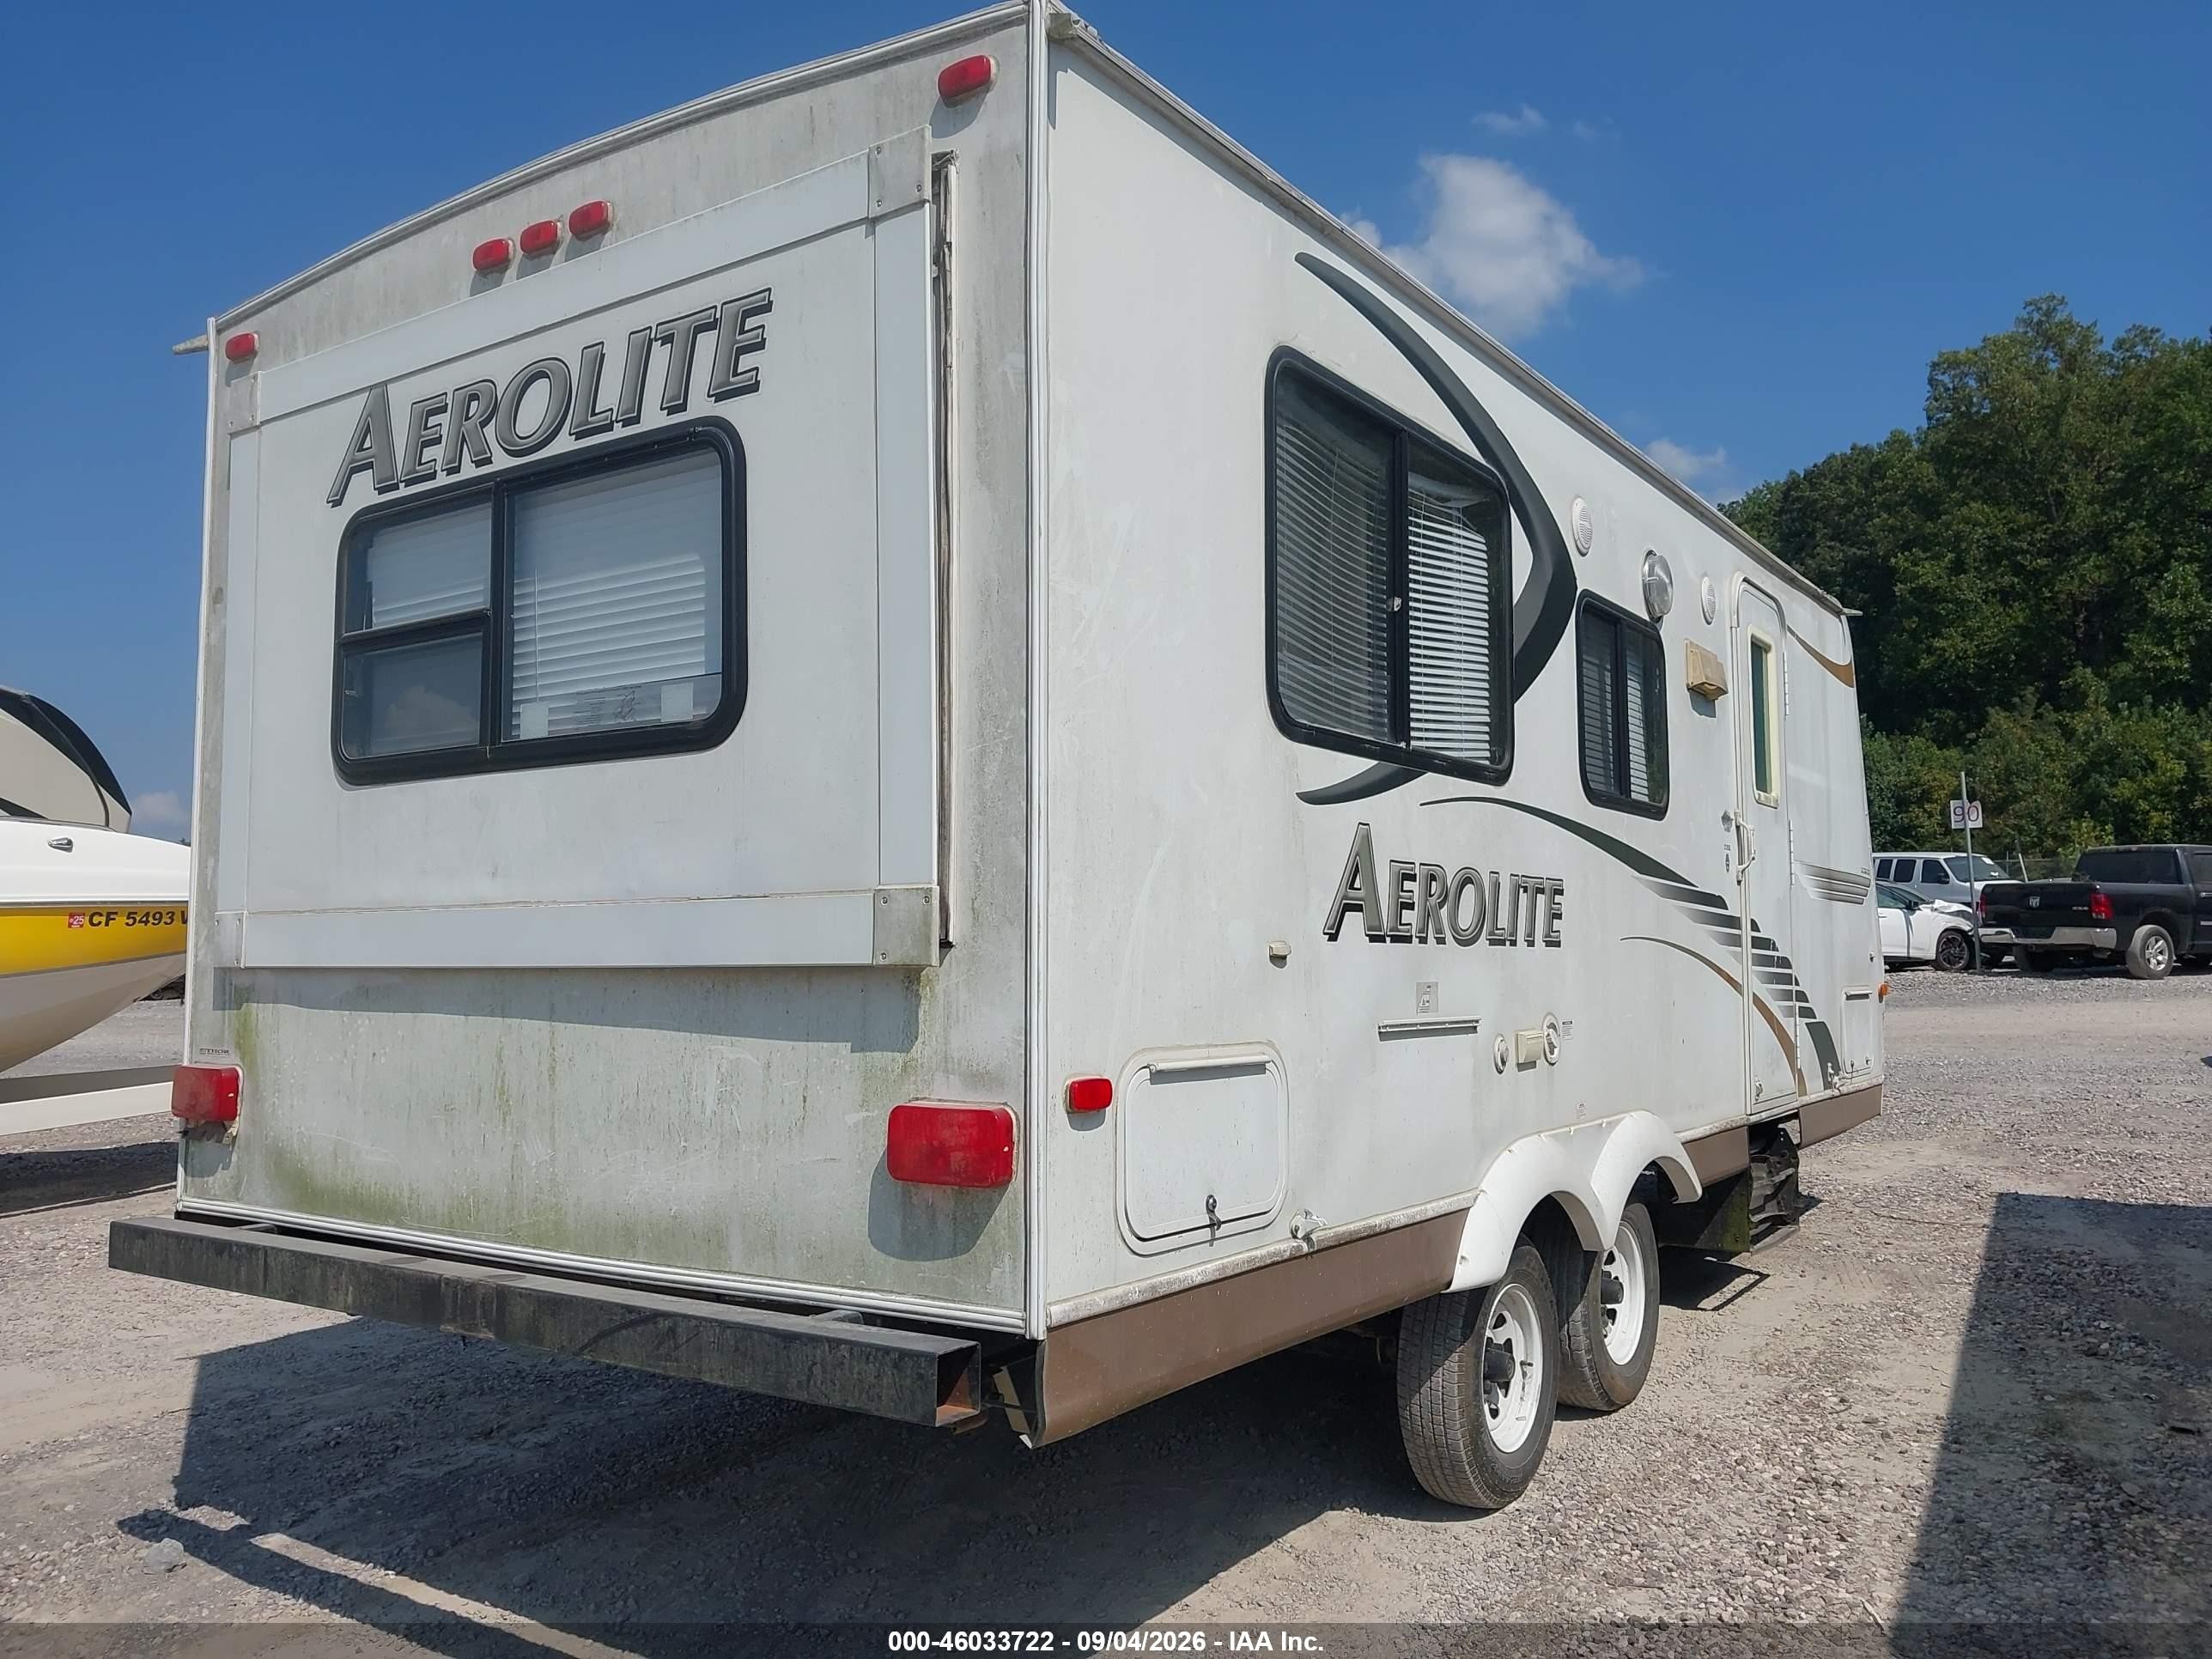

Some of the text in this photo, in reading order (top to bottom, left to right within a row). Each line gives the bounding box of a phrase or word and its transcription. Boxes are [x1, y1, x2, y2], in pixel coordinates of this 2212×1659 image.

[326, 287, 773, 507] AEROLITE
[1954, 805, 1979, 823] 90
[88, 911, 118, 927] CF
[125, 910, 176, 927] 5493
[1322, 821, 1565, 948] AEROLITE
